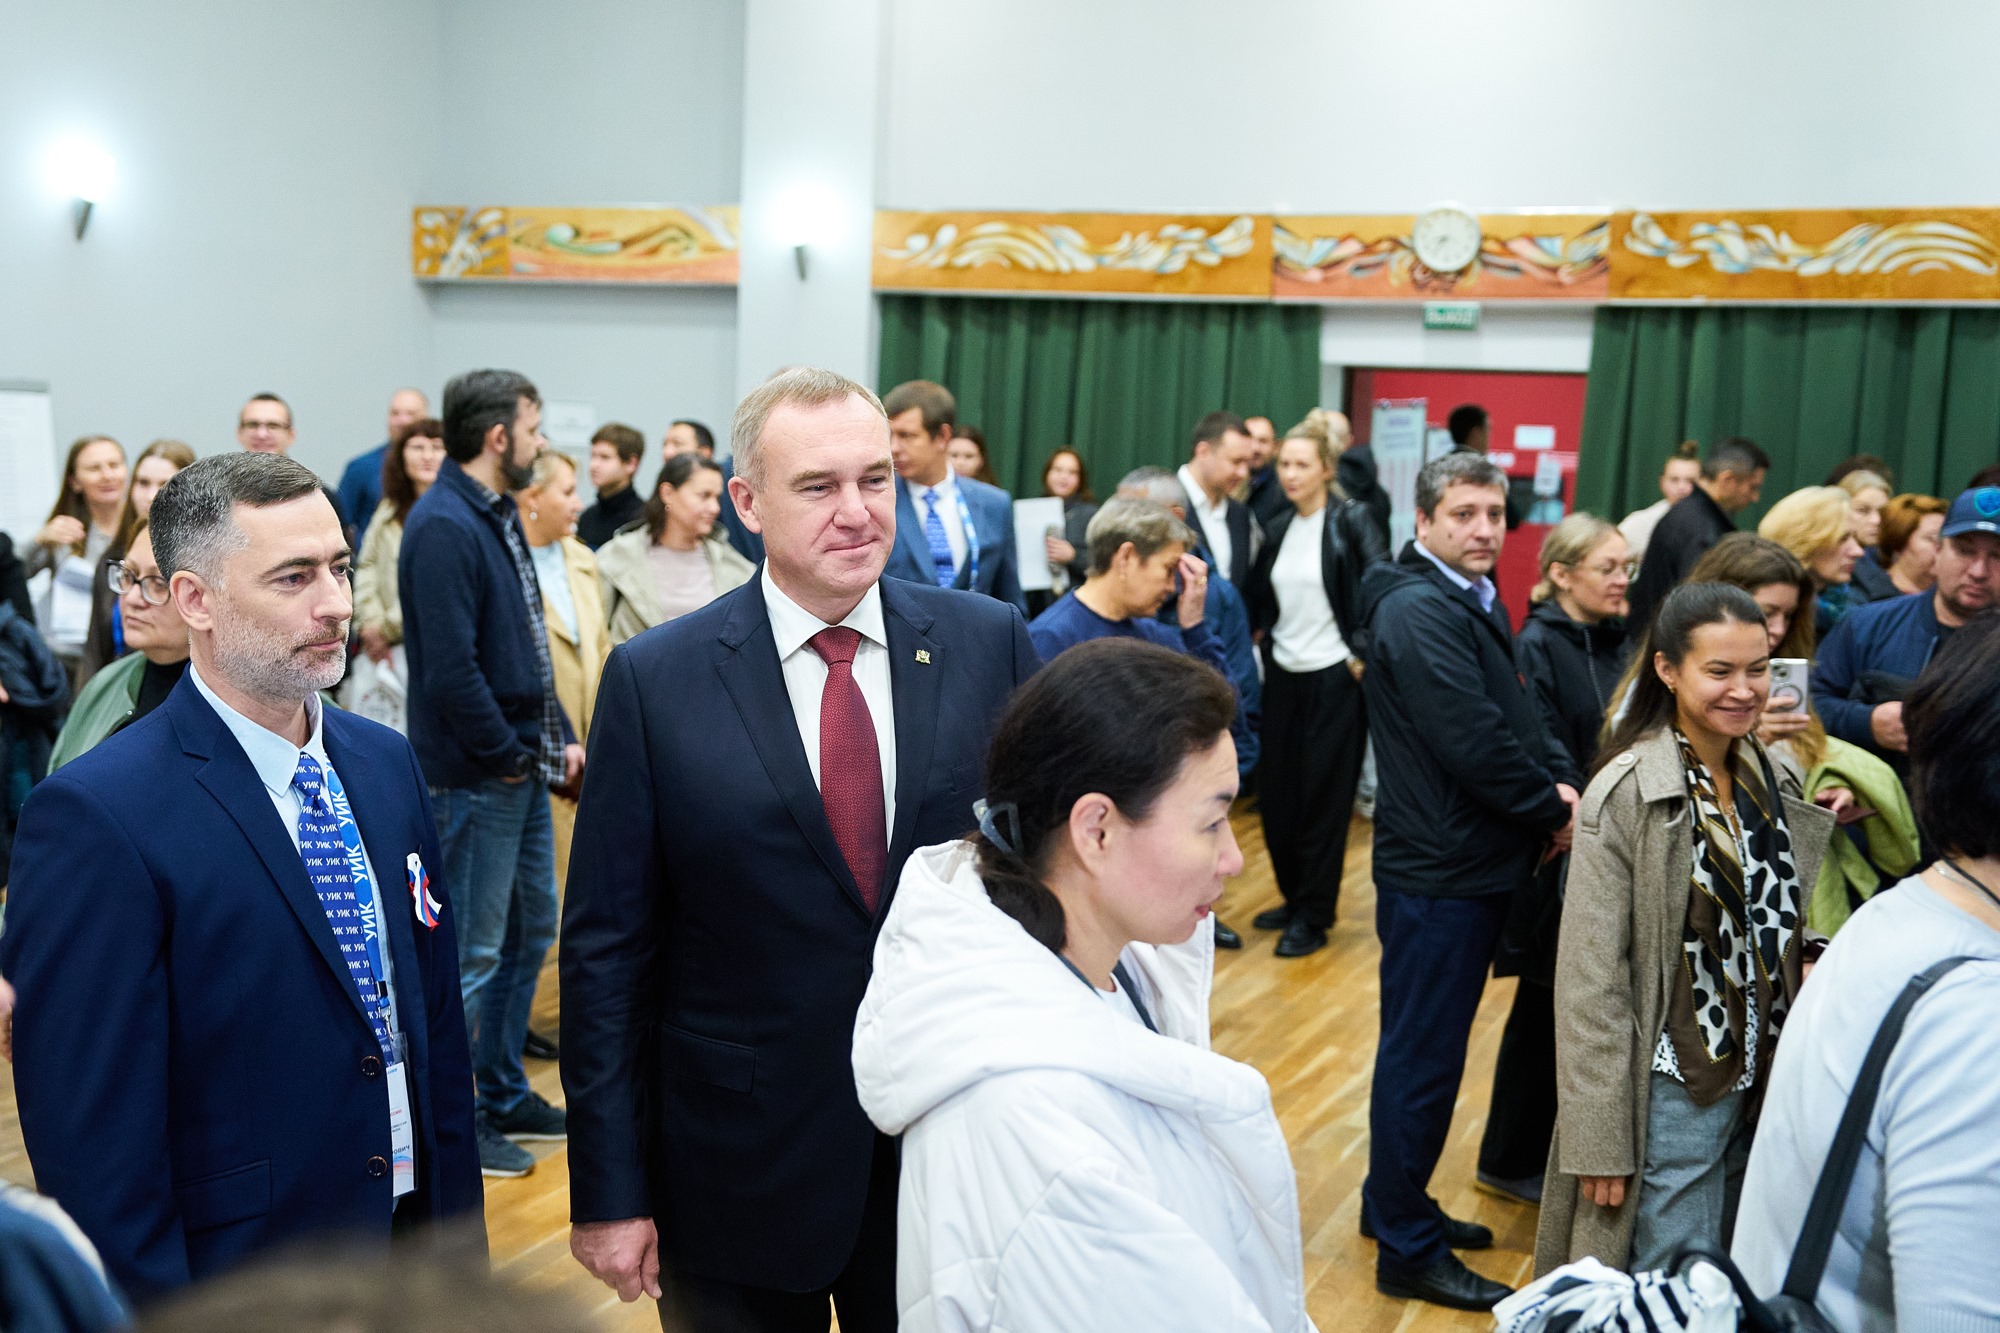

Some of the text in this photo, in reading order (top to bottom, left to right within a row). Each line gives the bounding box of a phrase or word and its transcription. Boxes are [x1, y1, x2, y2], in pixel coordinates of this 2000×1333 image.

[302, 780, 320, 790] УИК
[320, 823, 338, 833] УИК
[315, 840, 332, 849] УИК
[306, 857, 323, 867] УИК
[325, 857, 341, 866] УИК
[331, 791, 377, 942] УИК УИК УИК
[316, 874, 333, 884] УИК
[334, 874, 349, 883] УИК
[326, 892, 342, 901] УИК
[336, 909, 351, 918] УИК
[332, 926, 344, 935] ИК
[345, 926, 359, 935] УИК
[347, 960, 362, 970] УИК
[357, 977, 370, 986] УИК
